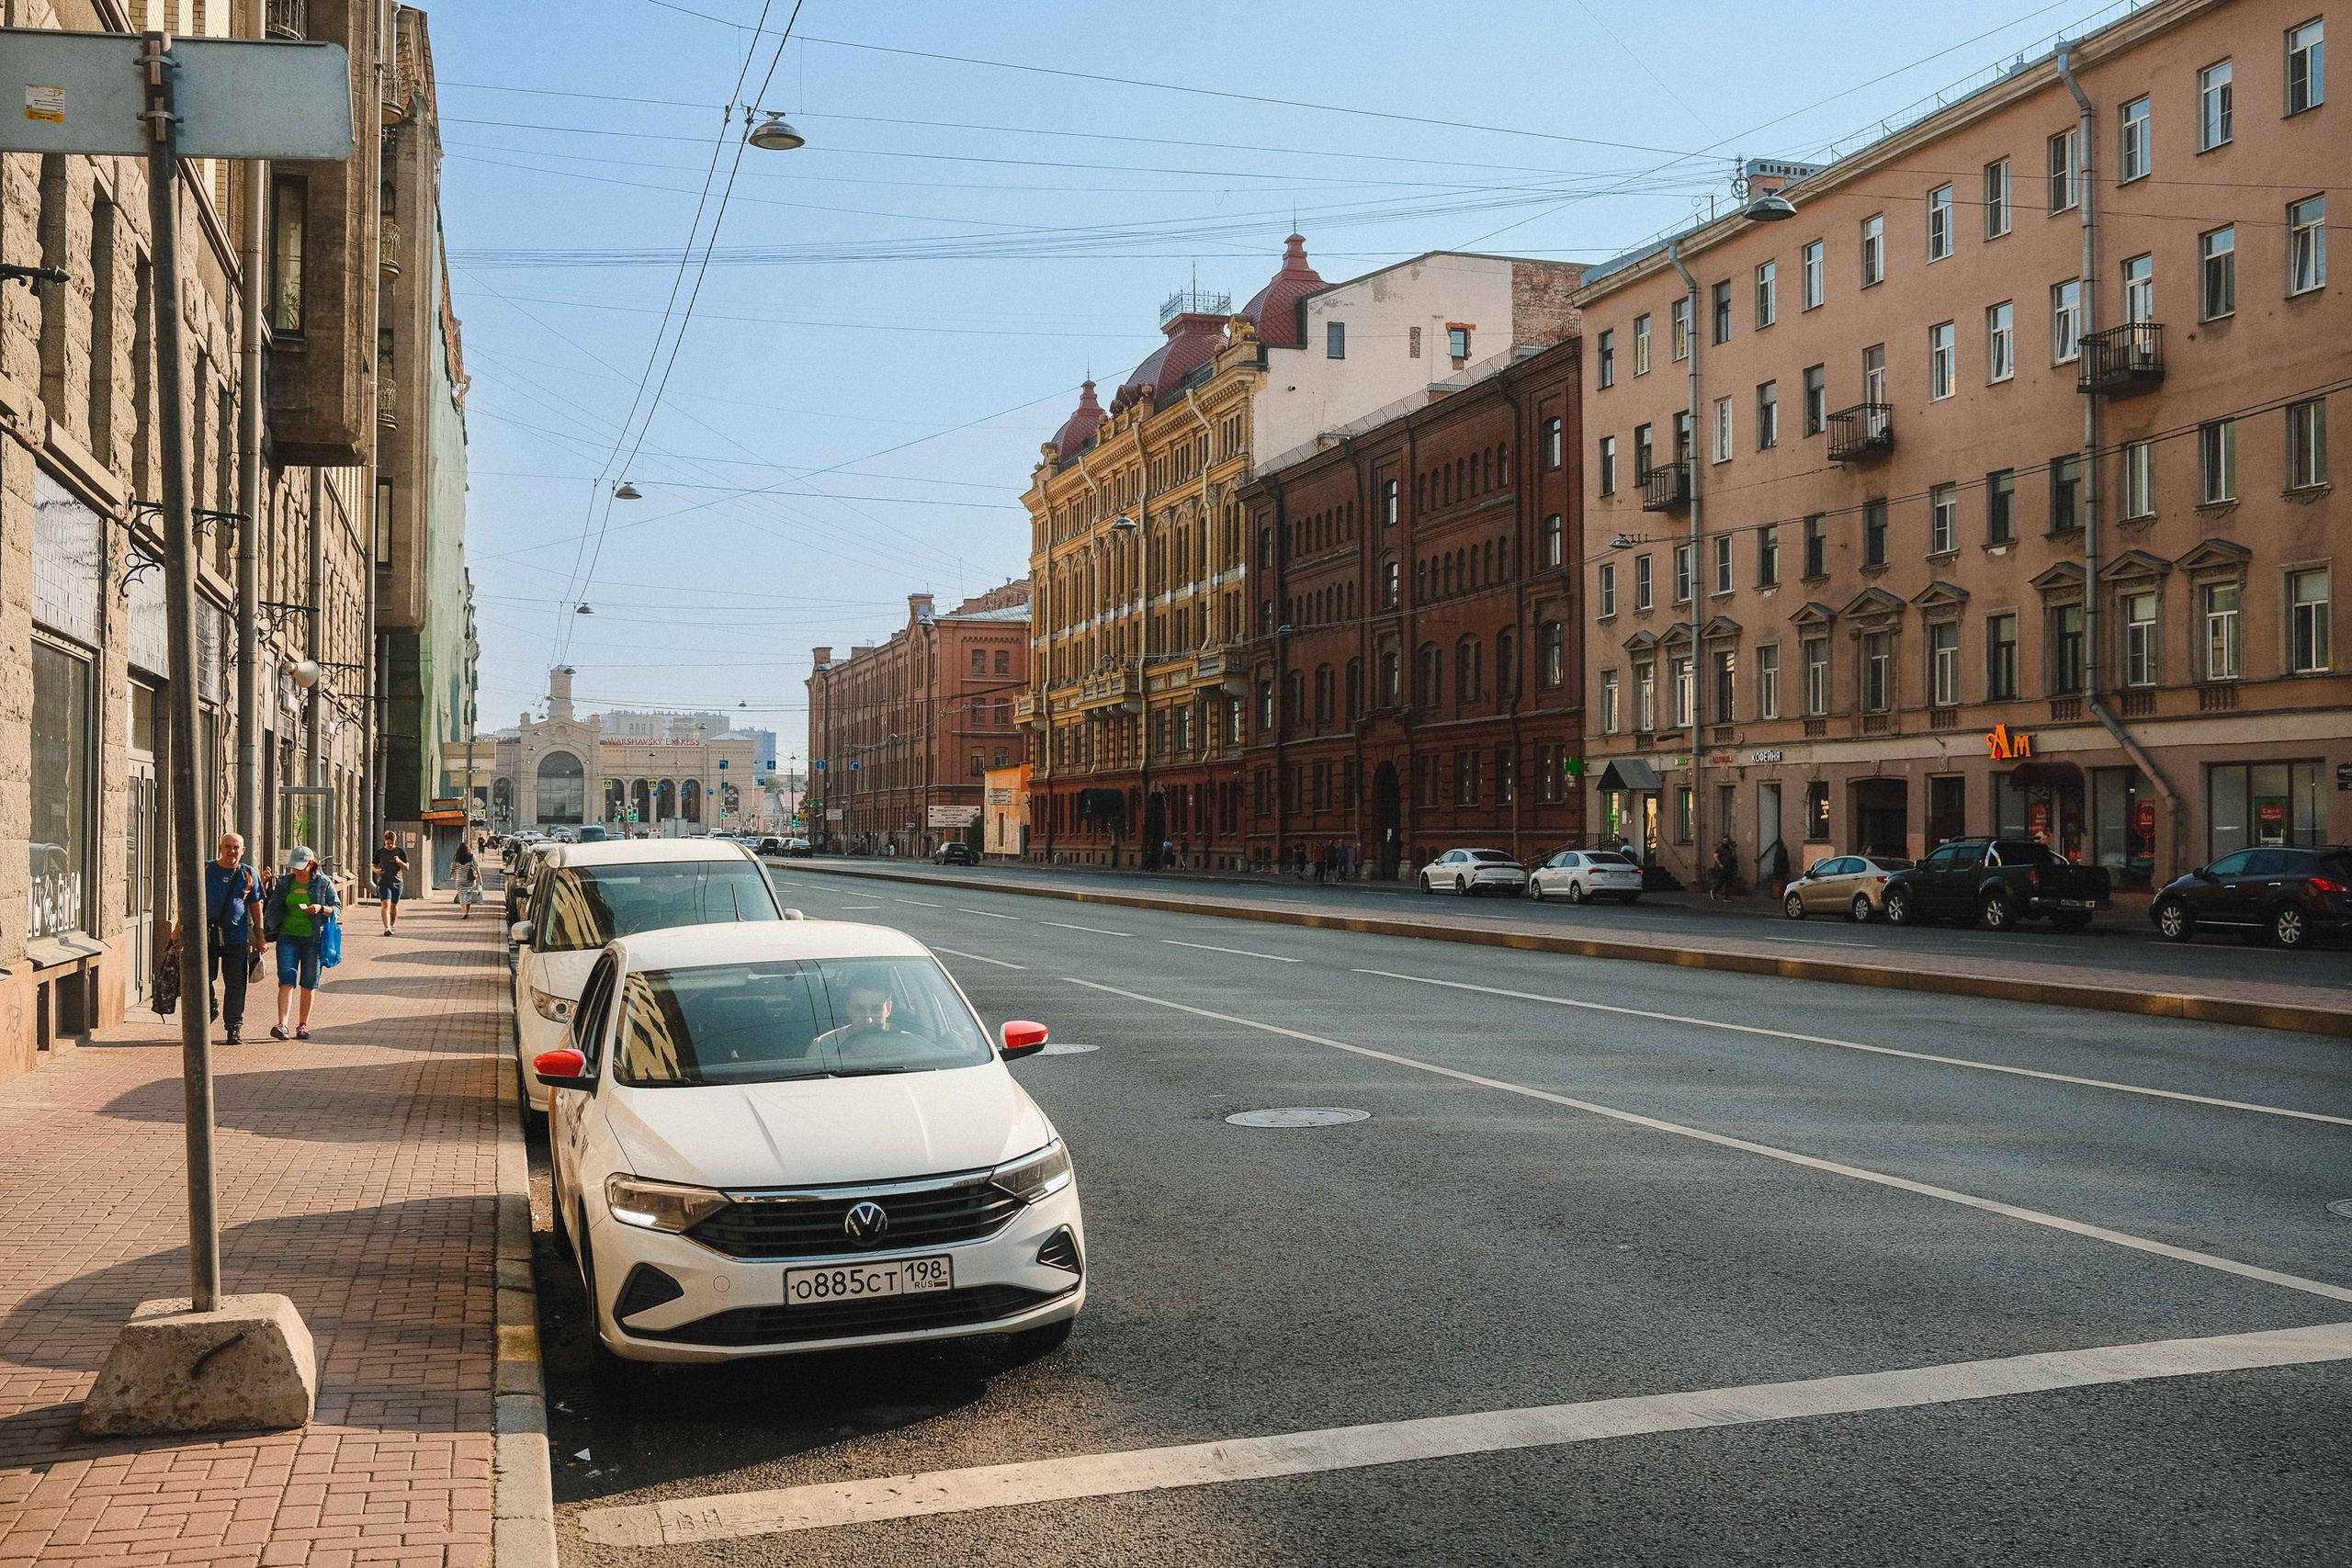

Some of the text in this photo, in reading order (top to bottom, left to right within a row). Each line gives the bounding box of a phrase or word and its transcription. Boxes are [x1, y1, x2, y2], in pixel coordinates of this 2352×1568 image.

[1751, 750, 1781, 763] КОФЕЙНЯ
[904, 1259, 943, 1282] 198
[914, 1280, 933, 1290] RUS
